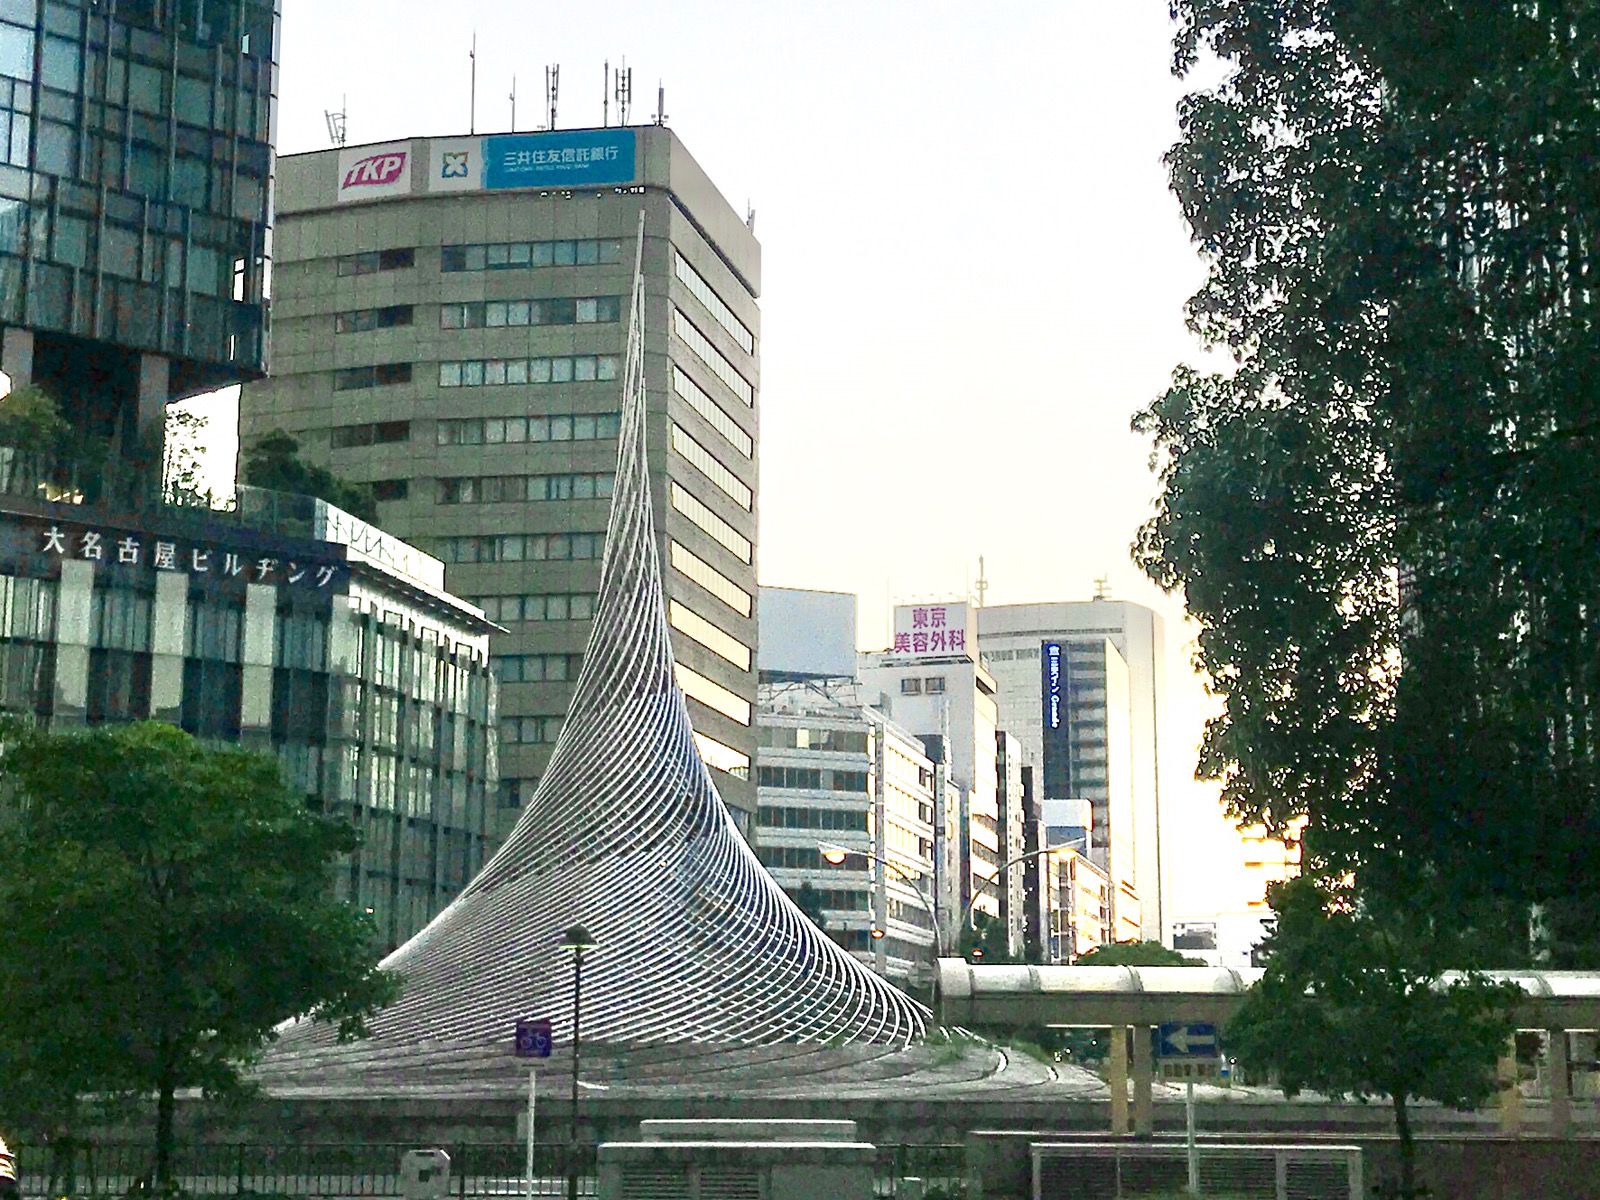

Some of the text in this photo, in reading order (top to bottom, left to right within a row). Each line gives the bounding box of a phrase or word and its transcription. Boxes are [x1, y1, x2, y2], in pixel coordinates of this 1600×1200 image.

[503, 146, 619, 166] 三井住友信託銀行
[344, 156, 402, 184] TKP
[913, 607, 947, 629] 東京
[895, 629, 965, 653] 美容外科
